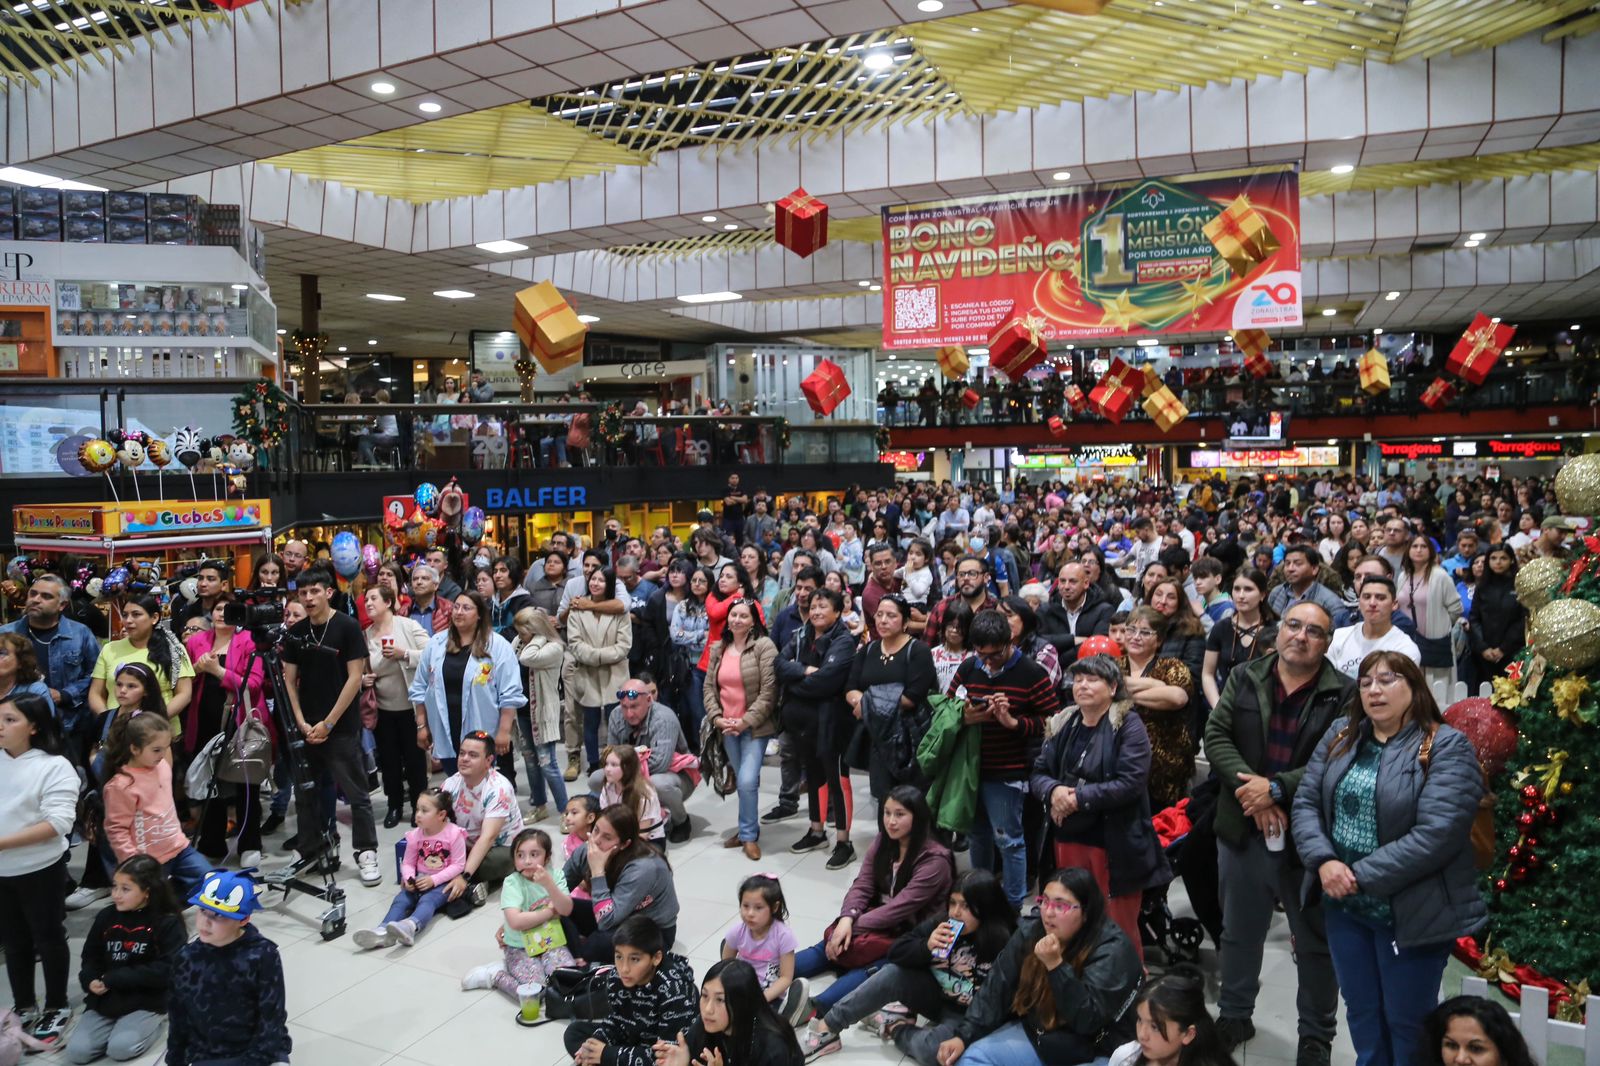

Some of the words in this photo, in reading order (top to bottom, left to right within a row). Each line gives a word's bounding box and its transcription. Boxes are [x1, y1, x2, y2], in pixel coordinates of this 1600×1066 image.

[889, 214, 919, 224] COMPRA
[920, 212, 930, 220] EN
[932, 208, 979, 218] ZONAUSTRAL
[989, 202, 1027, 212] PARTICIPA
[889, 216, 996, 254] BONO
[1128, 233, 1211, 250] MENSUAL
[1090, 213, 1135, 286] 1
[1128, 251, 1147, 260] POR
[1149, 248, 1174, 258] TODO
[1176, 247, 1190, 256] UN
[1191, 245, 1213, 255] AÑO
[890, 235, 1076, 284] NAVIDEÑO
[950, 302, 980, 310] ESCANEA
[950, 309, 978, 317] INGRESA
[966, 320, 996, 329] COMPRAS
[1488, 440, 1562, 457] Tarragona
[486, 485, 587, 508] BALFER
